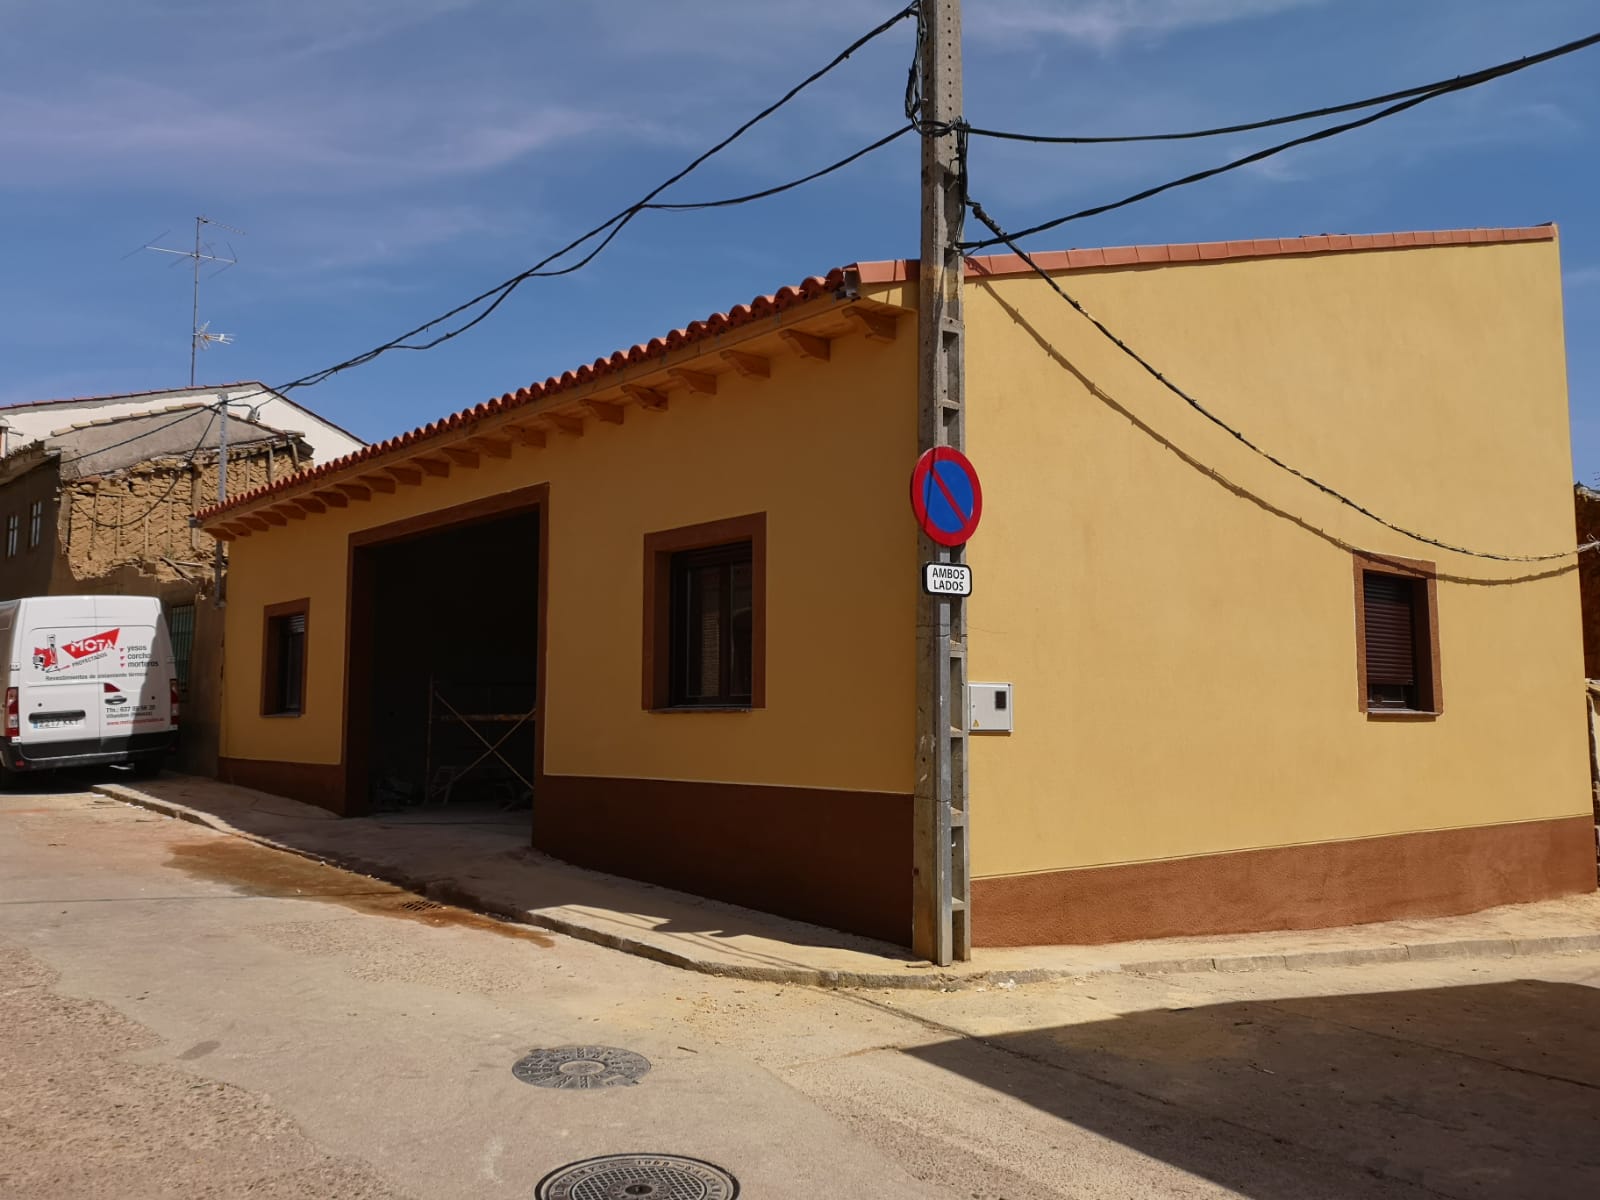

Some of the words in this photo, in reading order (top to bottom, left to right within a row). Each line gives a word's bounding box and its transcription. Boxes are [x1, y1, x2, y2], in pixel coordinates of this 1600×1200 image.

[932, 567, 965, 580] AMBOS
[933, 579, 964, 591] LADOS
[70, 638, 115, 652] MOTA
[127, 645, 148, 653] yesos
[127, 660, 160, 668] morteros
